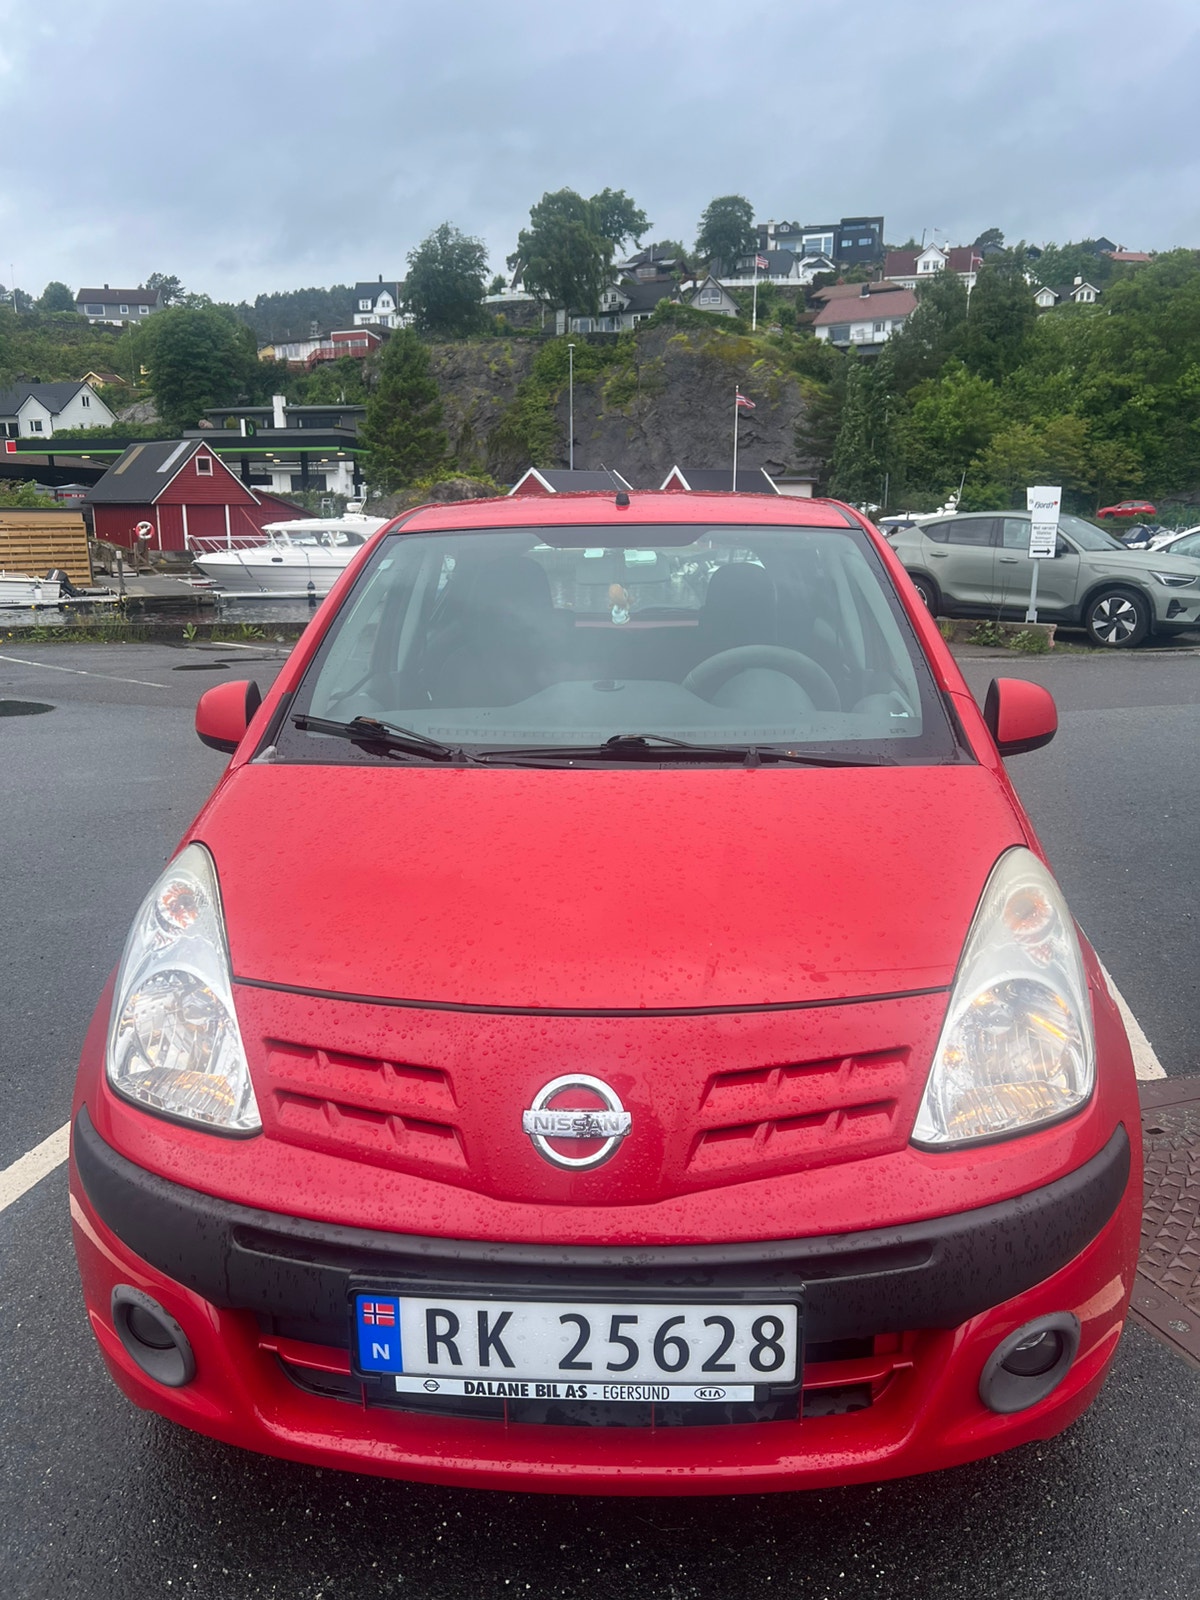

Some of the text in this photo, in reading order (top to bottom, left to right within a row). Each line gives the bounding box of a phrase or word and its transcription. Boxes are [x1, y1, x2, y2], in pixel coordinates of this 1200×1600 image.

[533, 1116, 620, 1132] NISSAN
[425, 1307, 786, 1373] RK 25628
[372, 1342, 390, 1360] N
[464, 1381, 529, 1397] DALANE
[535, 1384, 561, 1398] BIL
[603, 1385, 670, 1400] EGERSUND
